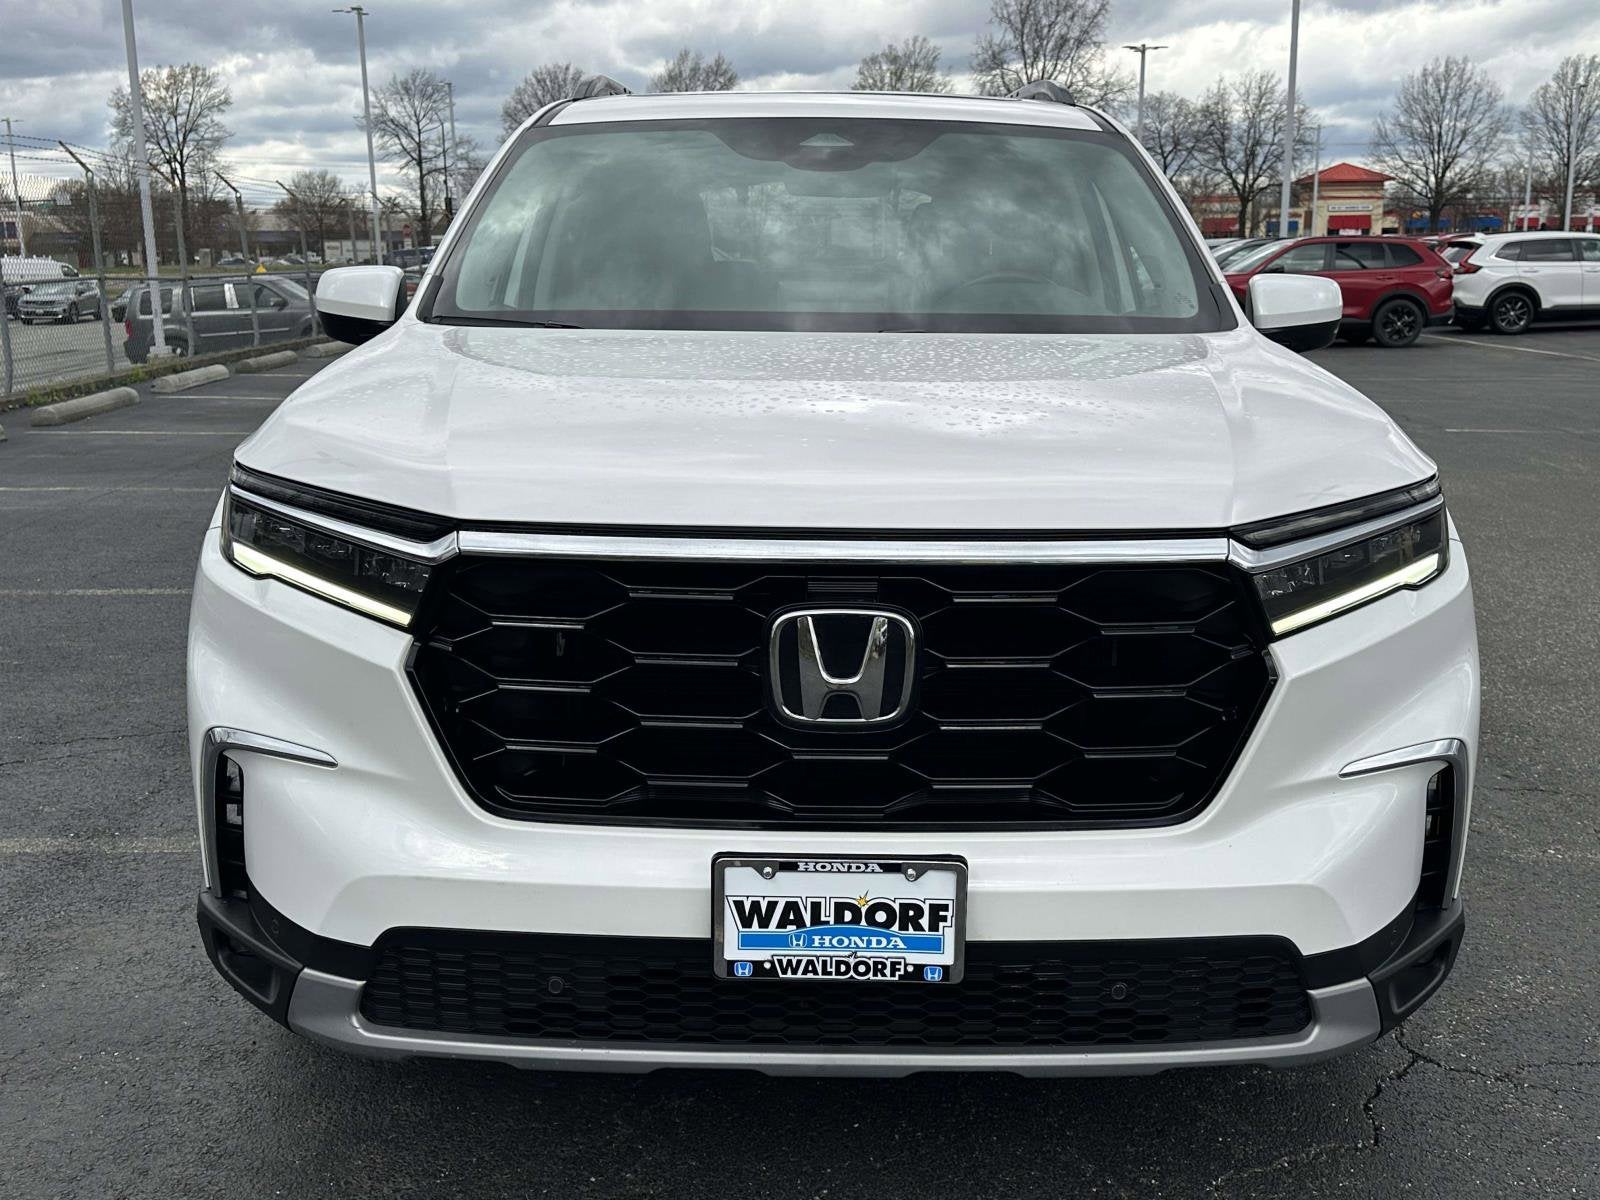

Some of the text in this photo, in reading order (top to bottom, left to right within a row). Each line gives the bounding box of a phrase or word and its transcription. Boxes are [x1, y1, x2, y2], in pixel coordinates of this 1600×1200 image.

[797, 862, 883, 873] HONDA
[731, 898, 950, 933] WALDORF
[811, 935, 907, 949] HONDA
[775, 957, 905, 979] WALDORF
